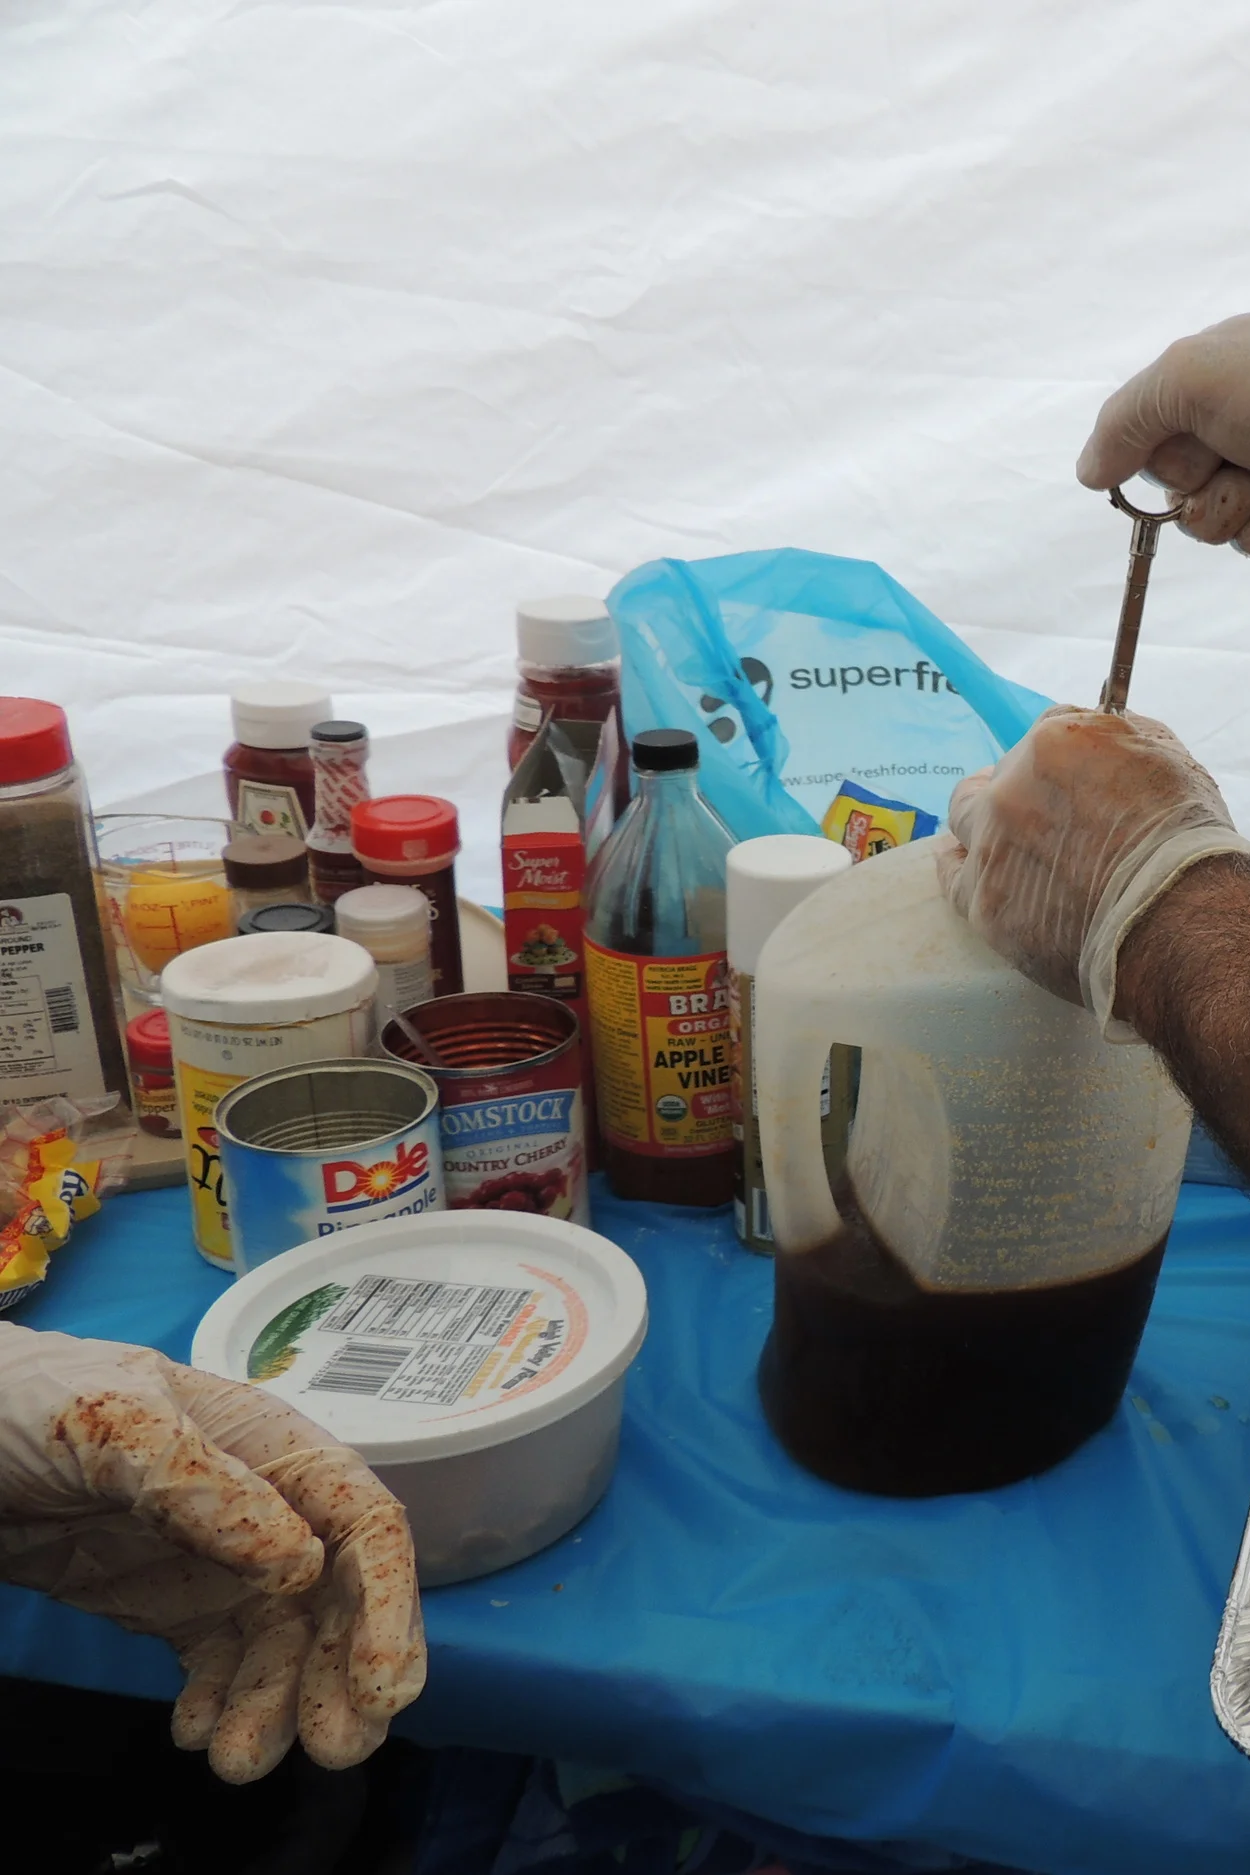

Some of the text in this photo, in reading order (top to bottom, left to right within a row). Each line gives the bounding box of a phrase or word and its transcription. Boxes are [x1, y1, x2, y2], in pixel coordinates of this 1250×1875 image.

[780, 763, 965, 786] ww.supereshfood.com
[508, 850, 560, 871] Super
[517, 869, 569, 889] Moist
[0, 935, 33, 944] ROUND
[0, 942, 45, 956] PEPPER
[668, 989, 730, 1016] BRA
[667, 1037, 697, 1047] RAW
[654, 1046, 724, 1068] APPLE
[678, 1065, 731, 1089] VINE
[441, 1097, 566, 1135] OMSTOCK
[466, 1139, 538, 1159] ORIGINAL
[322, 1141, 429, 1203] Dole
[443, 1158, 510, 1173] OUNTRY
[317, 1187, 437, 1237] Pipple
